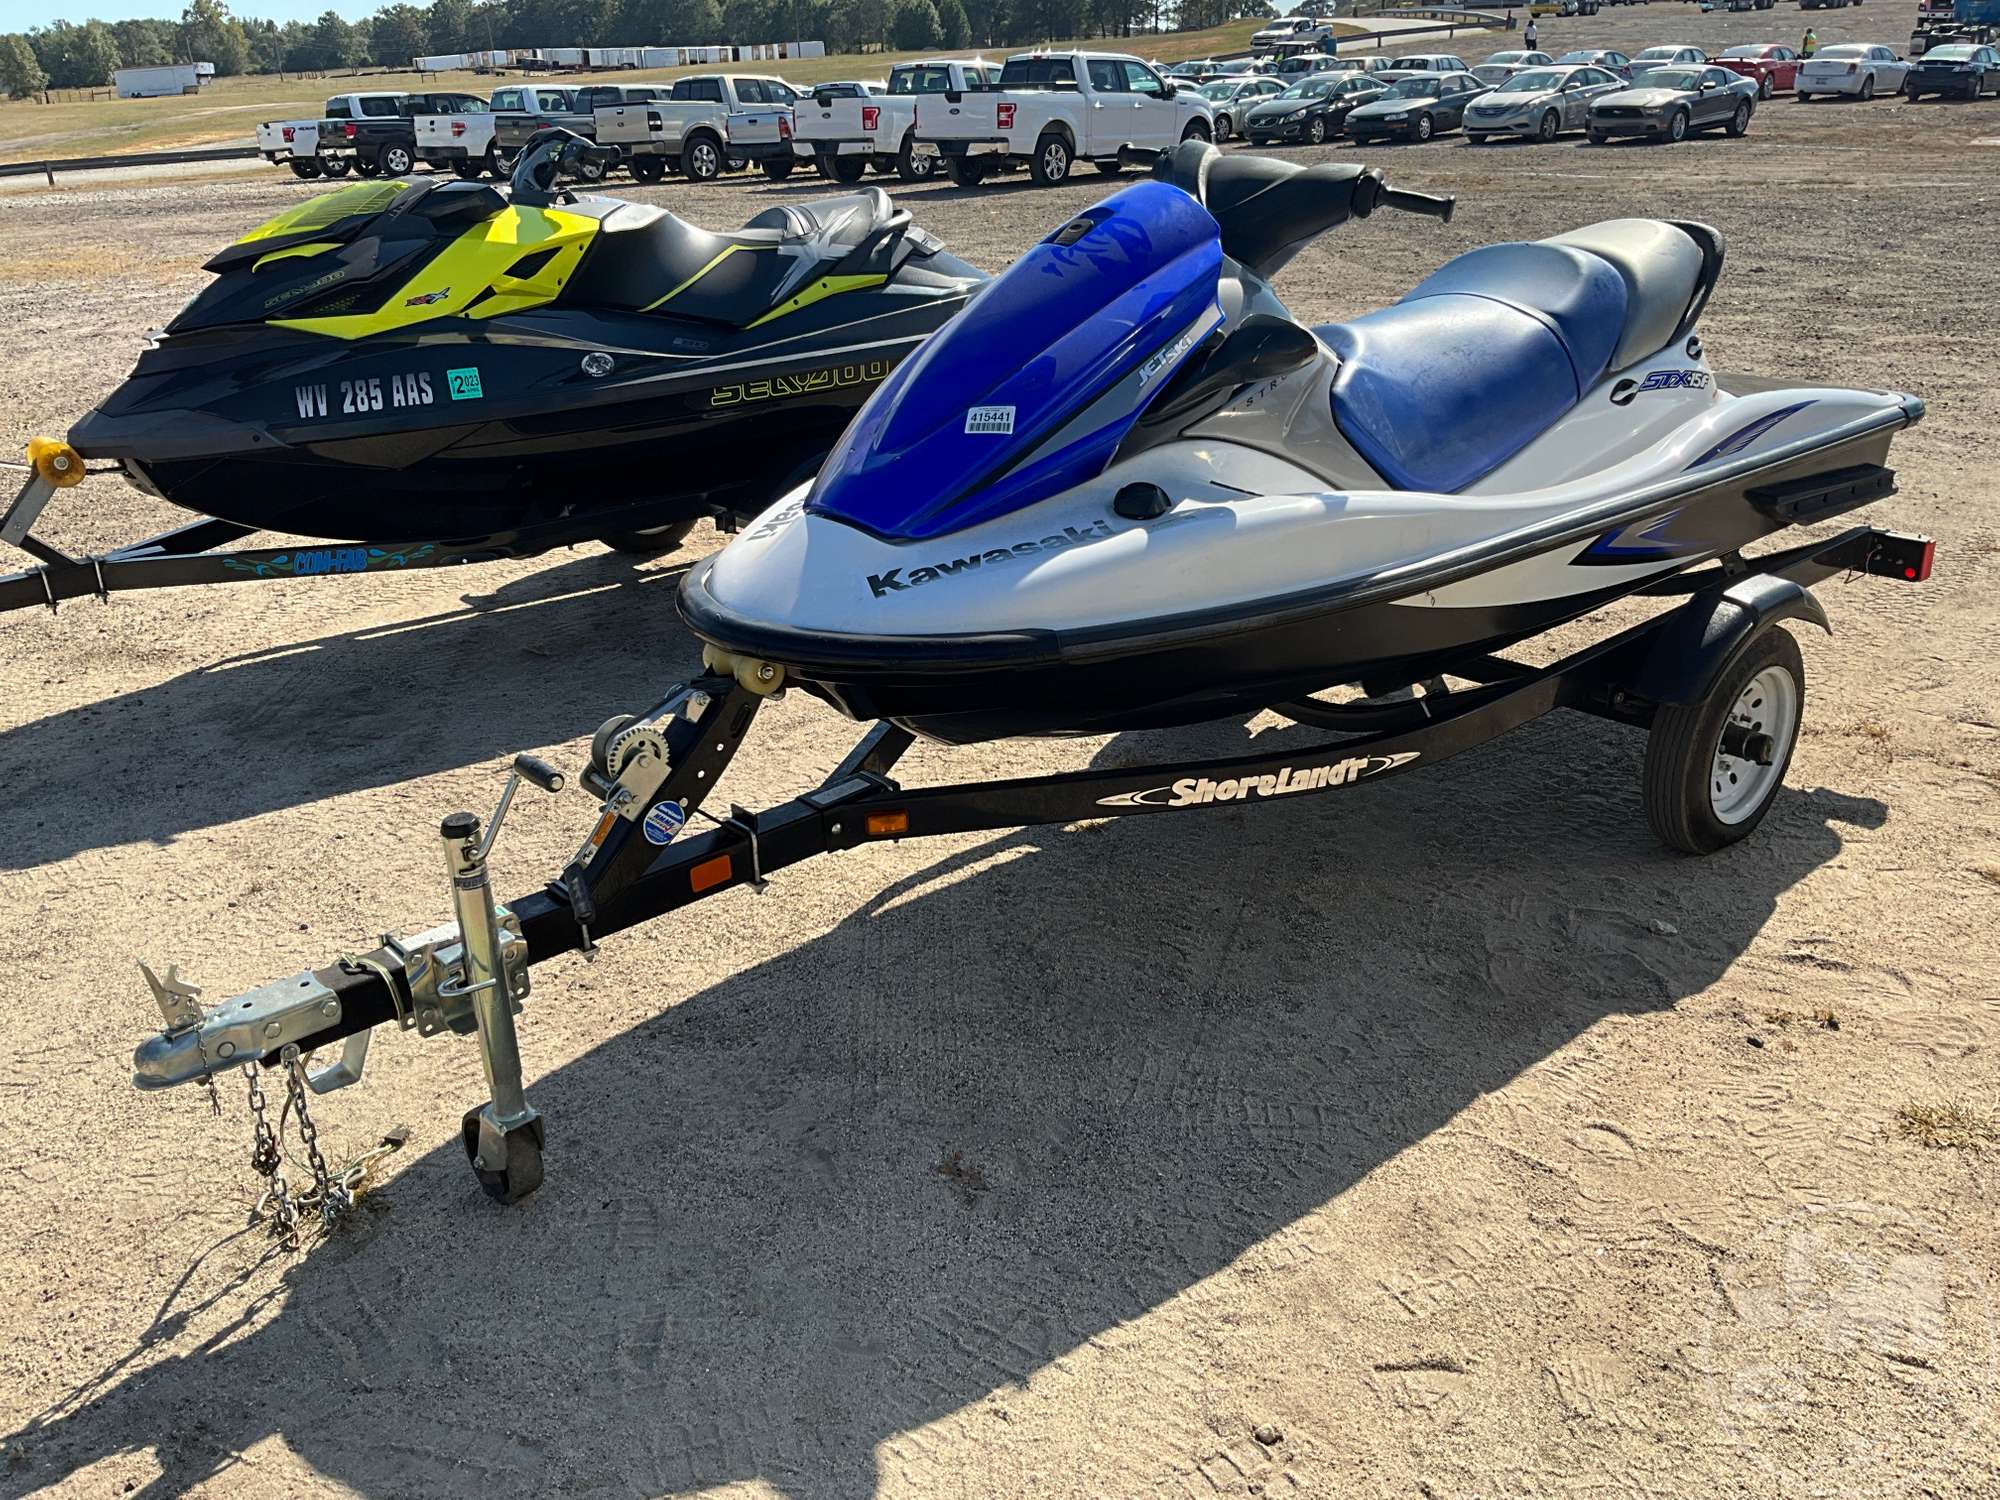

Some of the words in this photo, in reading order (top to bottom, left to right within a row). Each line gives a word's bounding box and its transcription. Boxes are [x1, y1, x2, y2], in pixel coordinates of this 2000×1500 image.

[295, 384, 328, 419] WV
[340, 378, 384, 414] 285
[392, 372, 434, 407] AAS
[971, 412, 1011, 422] 415441
[866, 519, 1118, 599] Kawasaki
